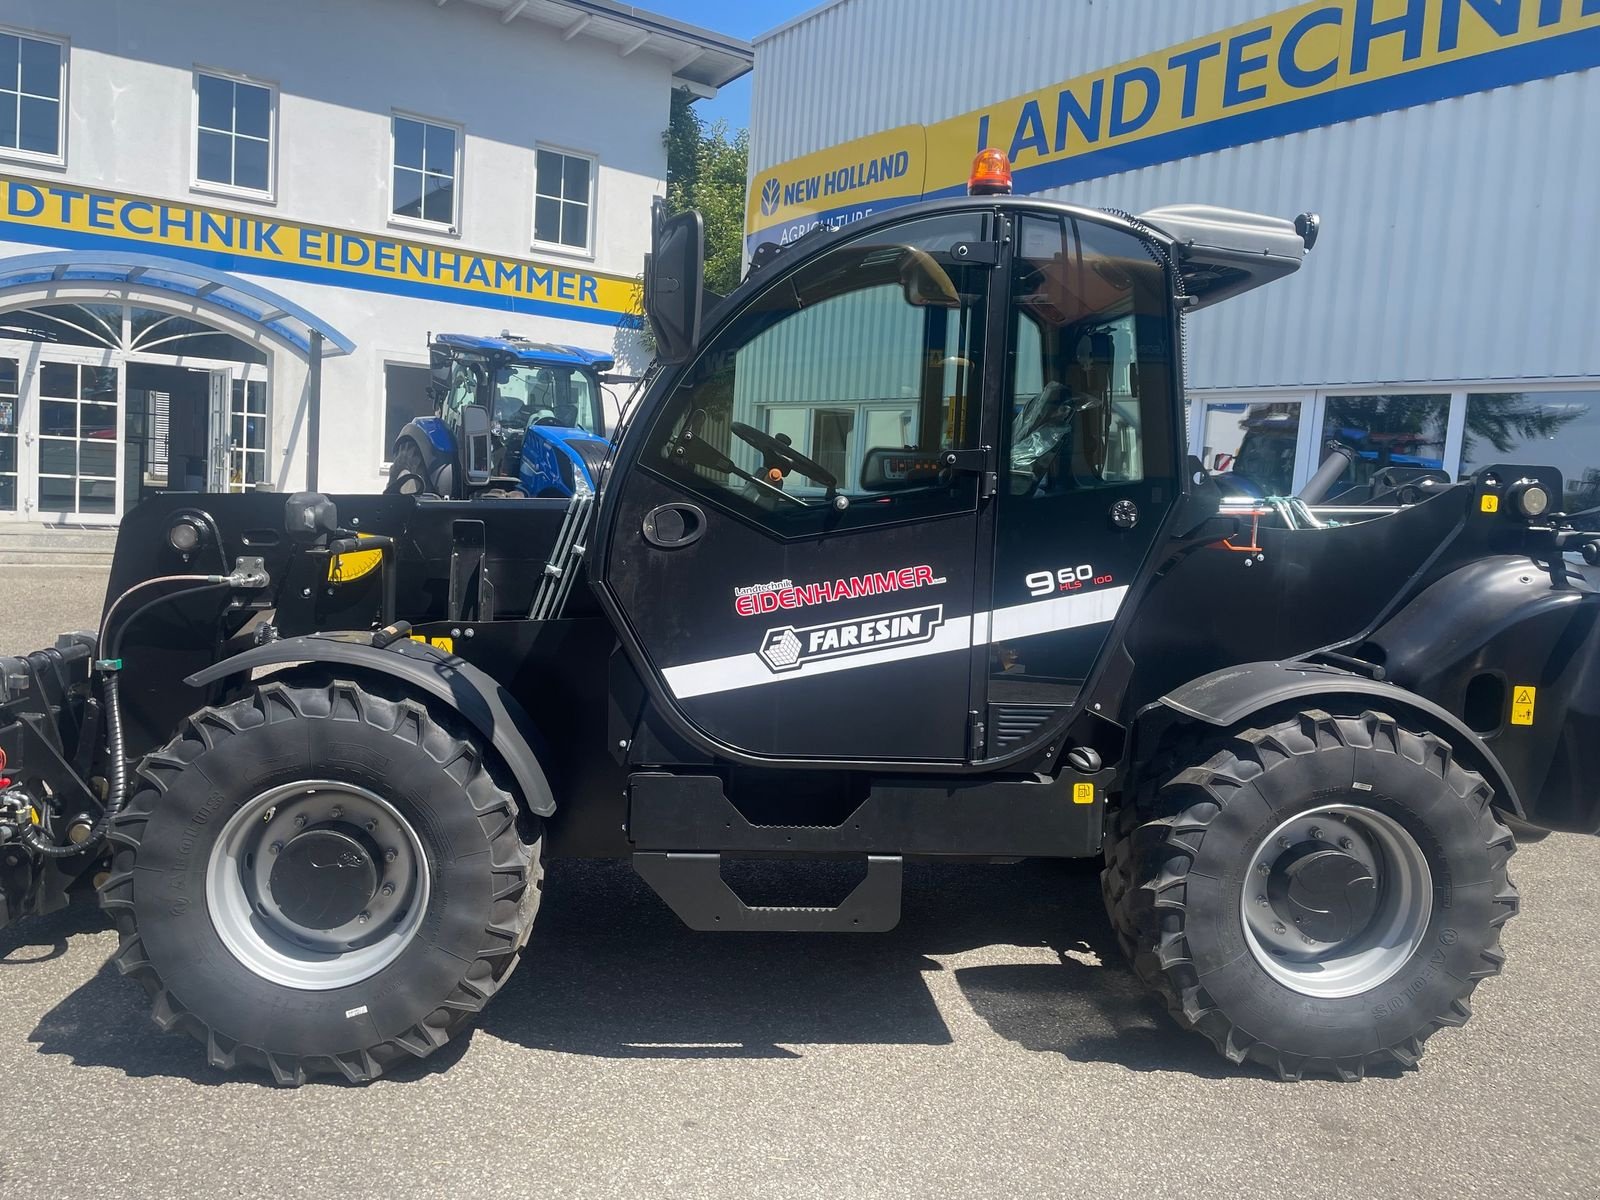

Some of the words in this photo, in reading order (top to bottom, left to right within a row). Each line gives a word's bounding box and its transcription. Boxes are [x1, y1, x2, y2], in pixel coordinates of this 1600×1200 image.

[977, 0, 1600, 164] ANDTECHN
[783, 174, 821, 207] NEW
[823, 150, 909, 197] HOLLAND
[8, 181, 283, 256] DTECHNIK
[299, 228, 599, 304] EIDENHAMMER
[734, 579, 793, 597] Landtechnik
[735, 564, 934, 617] EIDENHAMMER
[1025, 564, 1093, 597] 960
[1059, 580, 1082, 591] HLS
[1093, 574, 1113, 585] 100
[808, 613, 922, 653] FARESIN
